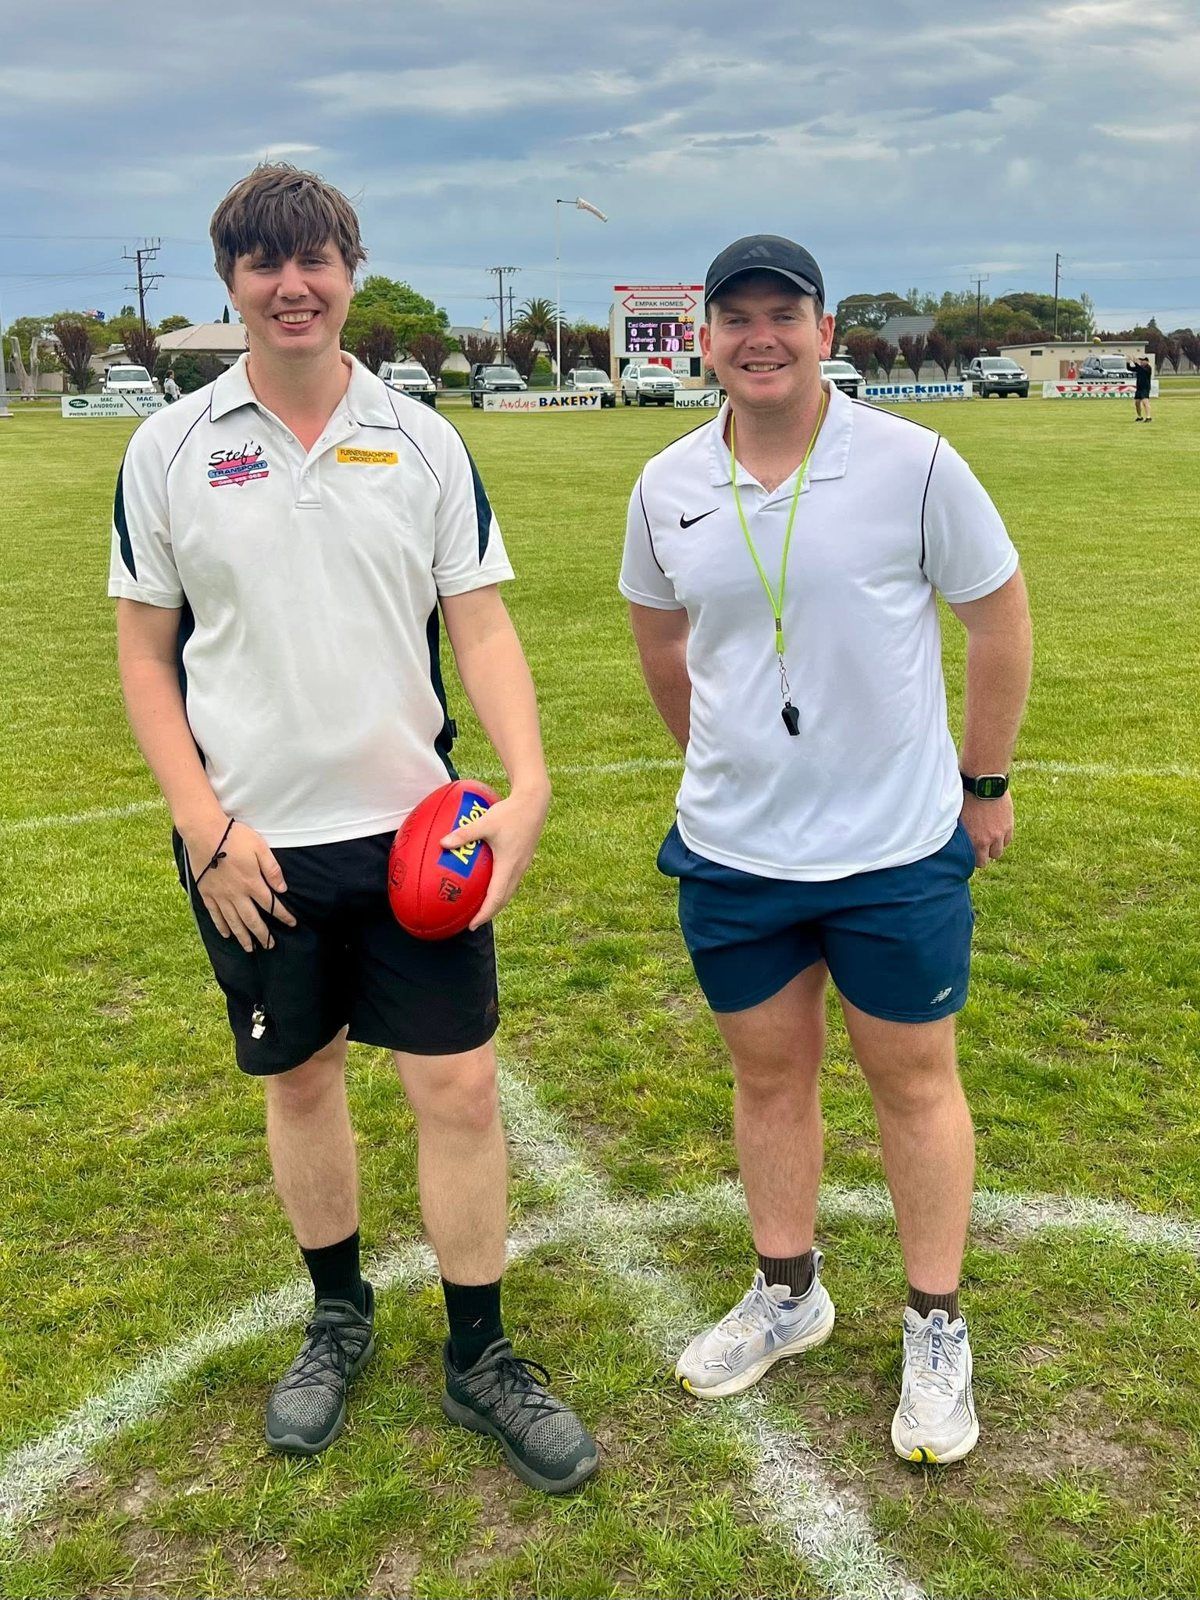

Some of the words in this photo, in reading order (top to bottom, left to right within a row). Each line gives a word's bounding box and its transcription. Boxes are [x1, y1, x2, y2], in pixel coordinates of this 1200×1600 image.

[630, 328, 638, 337] 0
[647, 328, 653, 337] 1
[669, 323, 676, 336] 1
[628, 343, 640, 351] 11
[646, 343, 654, 351] 4
[665, 338, 680, 352] 70
[865, 384, 964, 396] quickmix
[500, 398, 537, 410] Andys
[539, 395, 599, 407] BAKERY
[676, 400, 709, 408] NUSKE
[208, 440, 265, 466] Stef's
[213, 461, 265, 475] TRANSPORT
